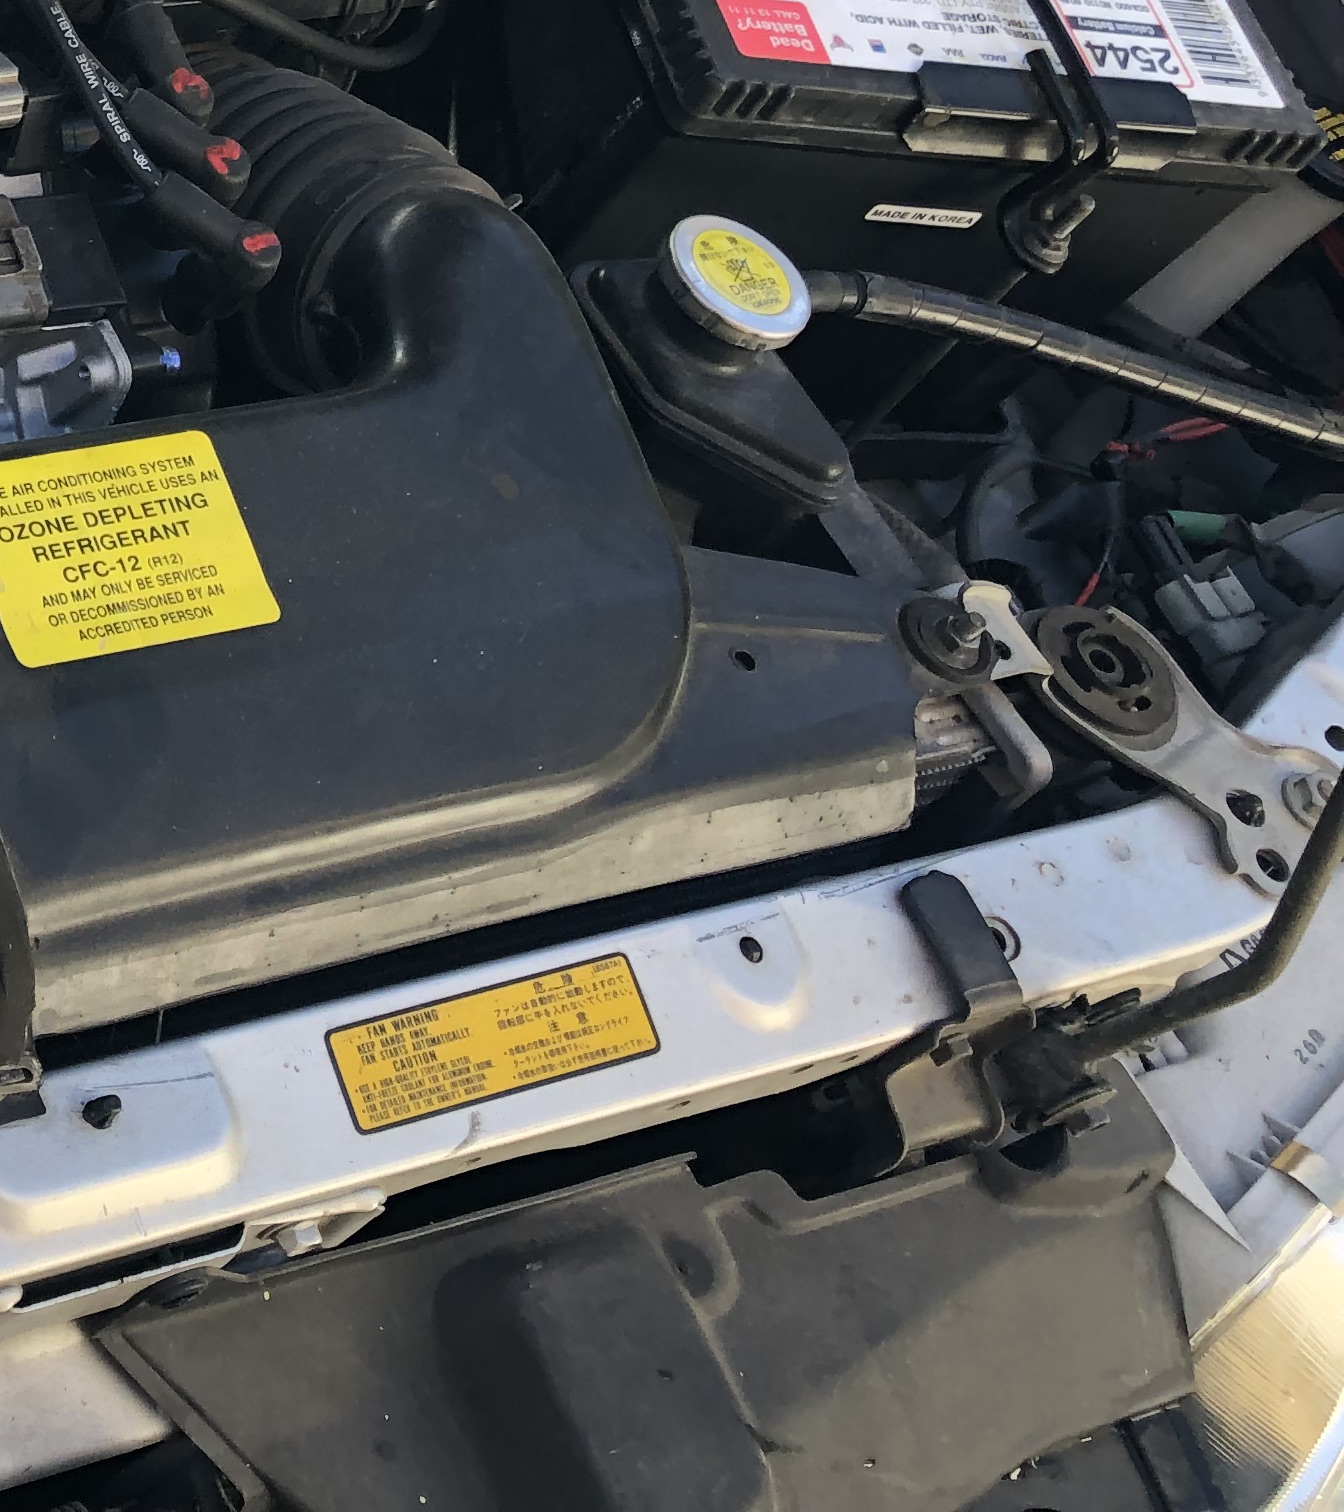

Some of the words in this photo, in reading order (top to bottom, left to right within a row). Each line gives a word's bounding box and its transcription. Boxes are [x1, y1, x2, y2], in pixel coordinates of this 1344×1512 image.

[737, 17, 808, 37] Battery?
[776, 9, 801, 20] CALL
[888, 15, 920, 29] WITH
[922, 19, 963, 34] FILLED
[769, 35, 816, 52] Dead
[75, 53, 100, 90] WIRE
[1085, 40, 1179, 76] 2544
[98, 93, 132, 143] SPIRAL
[871, 209, 910, 220] MADE
[911, 212, 928, 221] IN
[928, 214, 974, 225] KOREA
[729, 277, 780, 296] DANGER
[12, 482, 35, 497] AIR
[37, 465, 137, 492] CONDITIONING
[139, 455, 196, 475] SYSTEM
[47, 496, 62, 510] IN
[63, 491, 96, 506] THIS
[97, 480, 158, 501] VEHICLE
[159, 473, 197, 491] USES
[200, 469, 220, 483] AN
[83, 492, 209, 528] DEPLETING
[32, 520, 192, 563] REFRIGERANT
[62, 555, 142, 583] CFC-12
[147, 552, 184, 571] (R12)
[42, 592, 68, 609] AND
[70, 586, 97, 602] MAY
[101, 579, 133, 597] ONLY
[136, 576, 155, 591] BE
[156, 564, 218, 587] SERVICED
[48, 613, 68, 627] OR
[70, 591, 185, 623] DECOMMISSIONED
[187, 587, 204, 601] BY
[207, 583, 226, 597] AN
[79, 616, 159, 642] ACCREDITED
[161, 605, 214, 626] PERSON
[366, 1023, 387, 1040] FAN
[390, 1008, 440, 1032] WARNING
[356, 1041, 376, 1056] KEEP
[379, 1032, 406, 1048] HANDS
[360, 1052, 377, 1067] FAN
[379, 1043, 409, 1061] STARTS
[392, 1050, 438, 1073] CAUTION
[408, 1084, 446, 1101] MAINTENANCE
[368, 1111, 390, 1123] PLEASE
